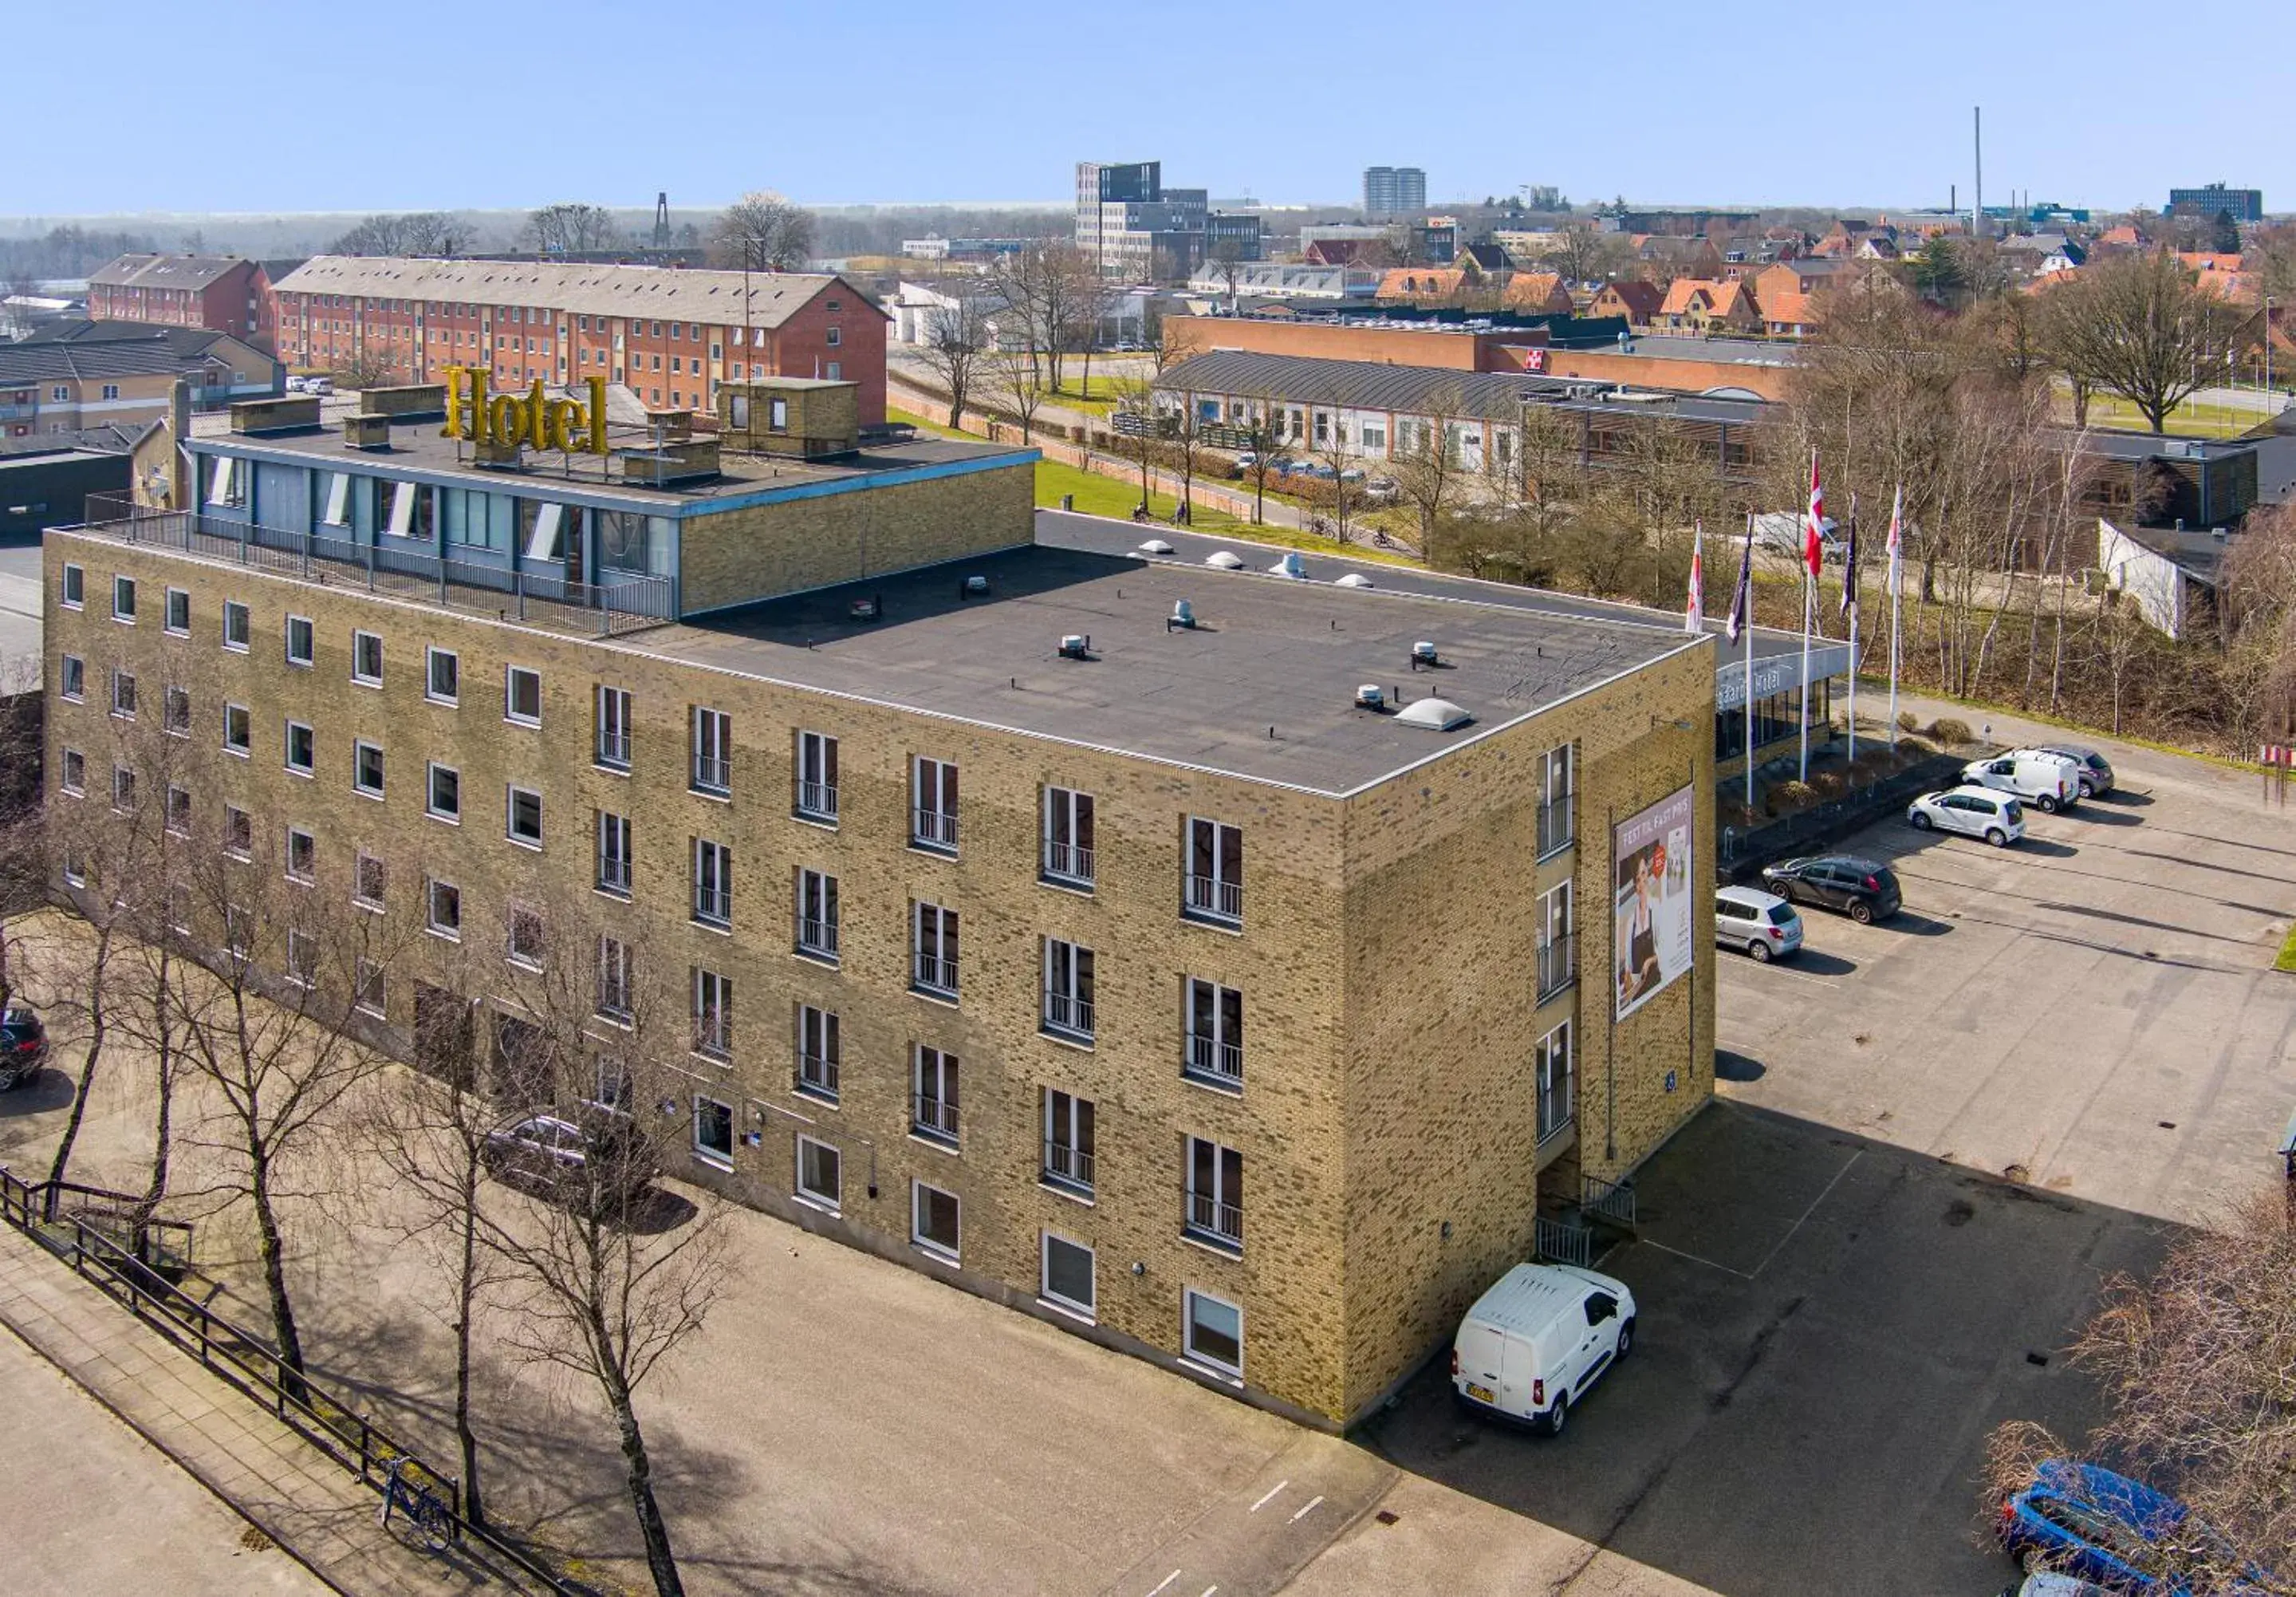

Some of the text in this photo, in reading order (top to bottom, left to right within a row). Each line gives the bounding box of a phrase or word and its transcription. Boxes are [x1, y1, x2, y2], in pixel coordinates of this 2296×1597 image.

[440, 365, 611, 456] Hotel
[1623, 824, 1640, 849] FEST
[1654, 807, 1671, 829] FAST
